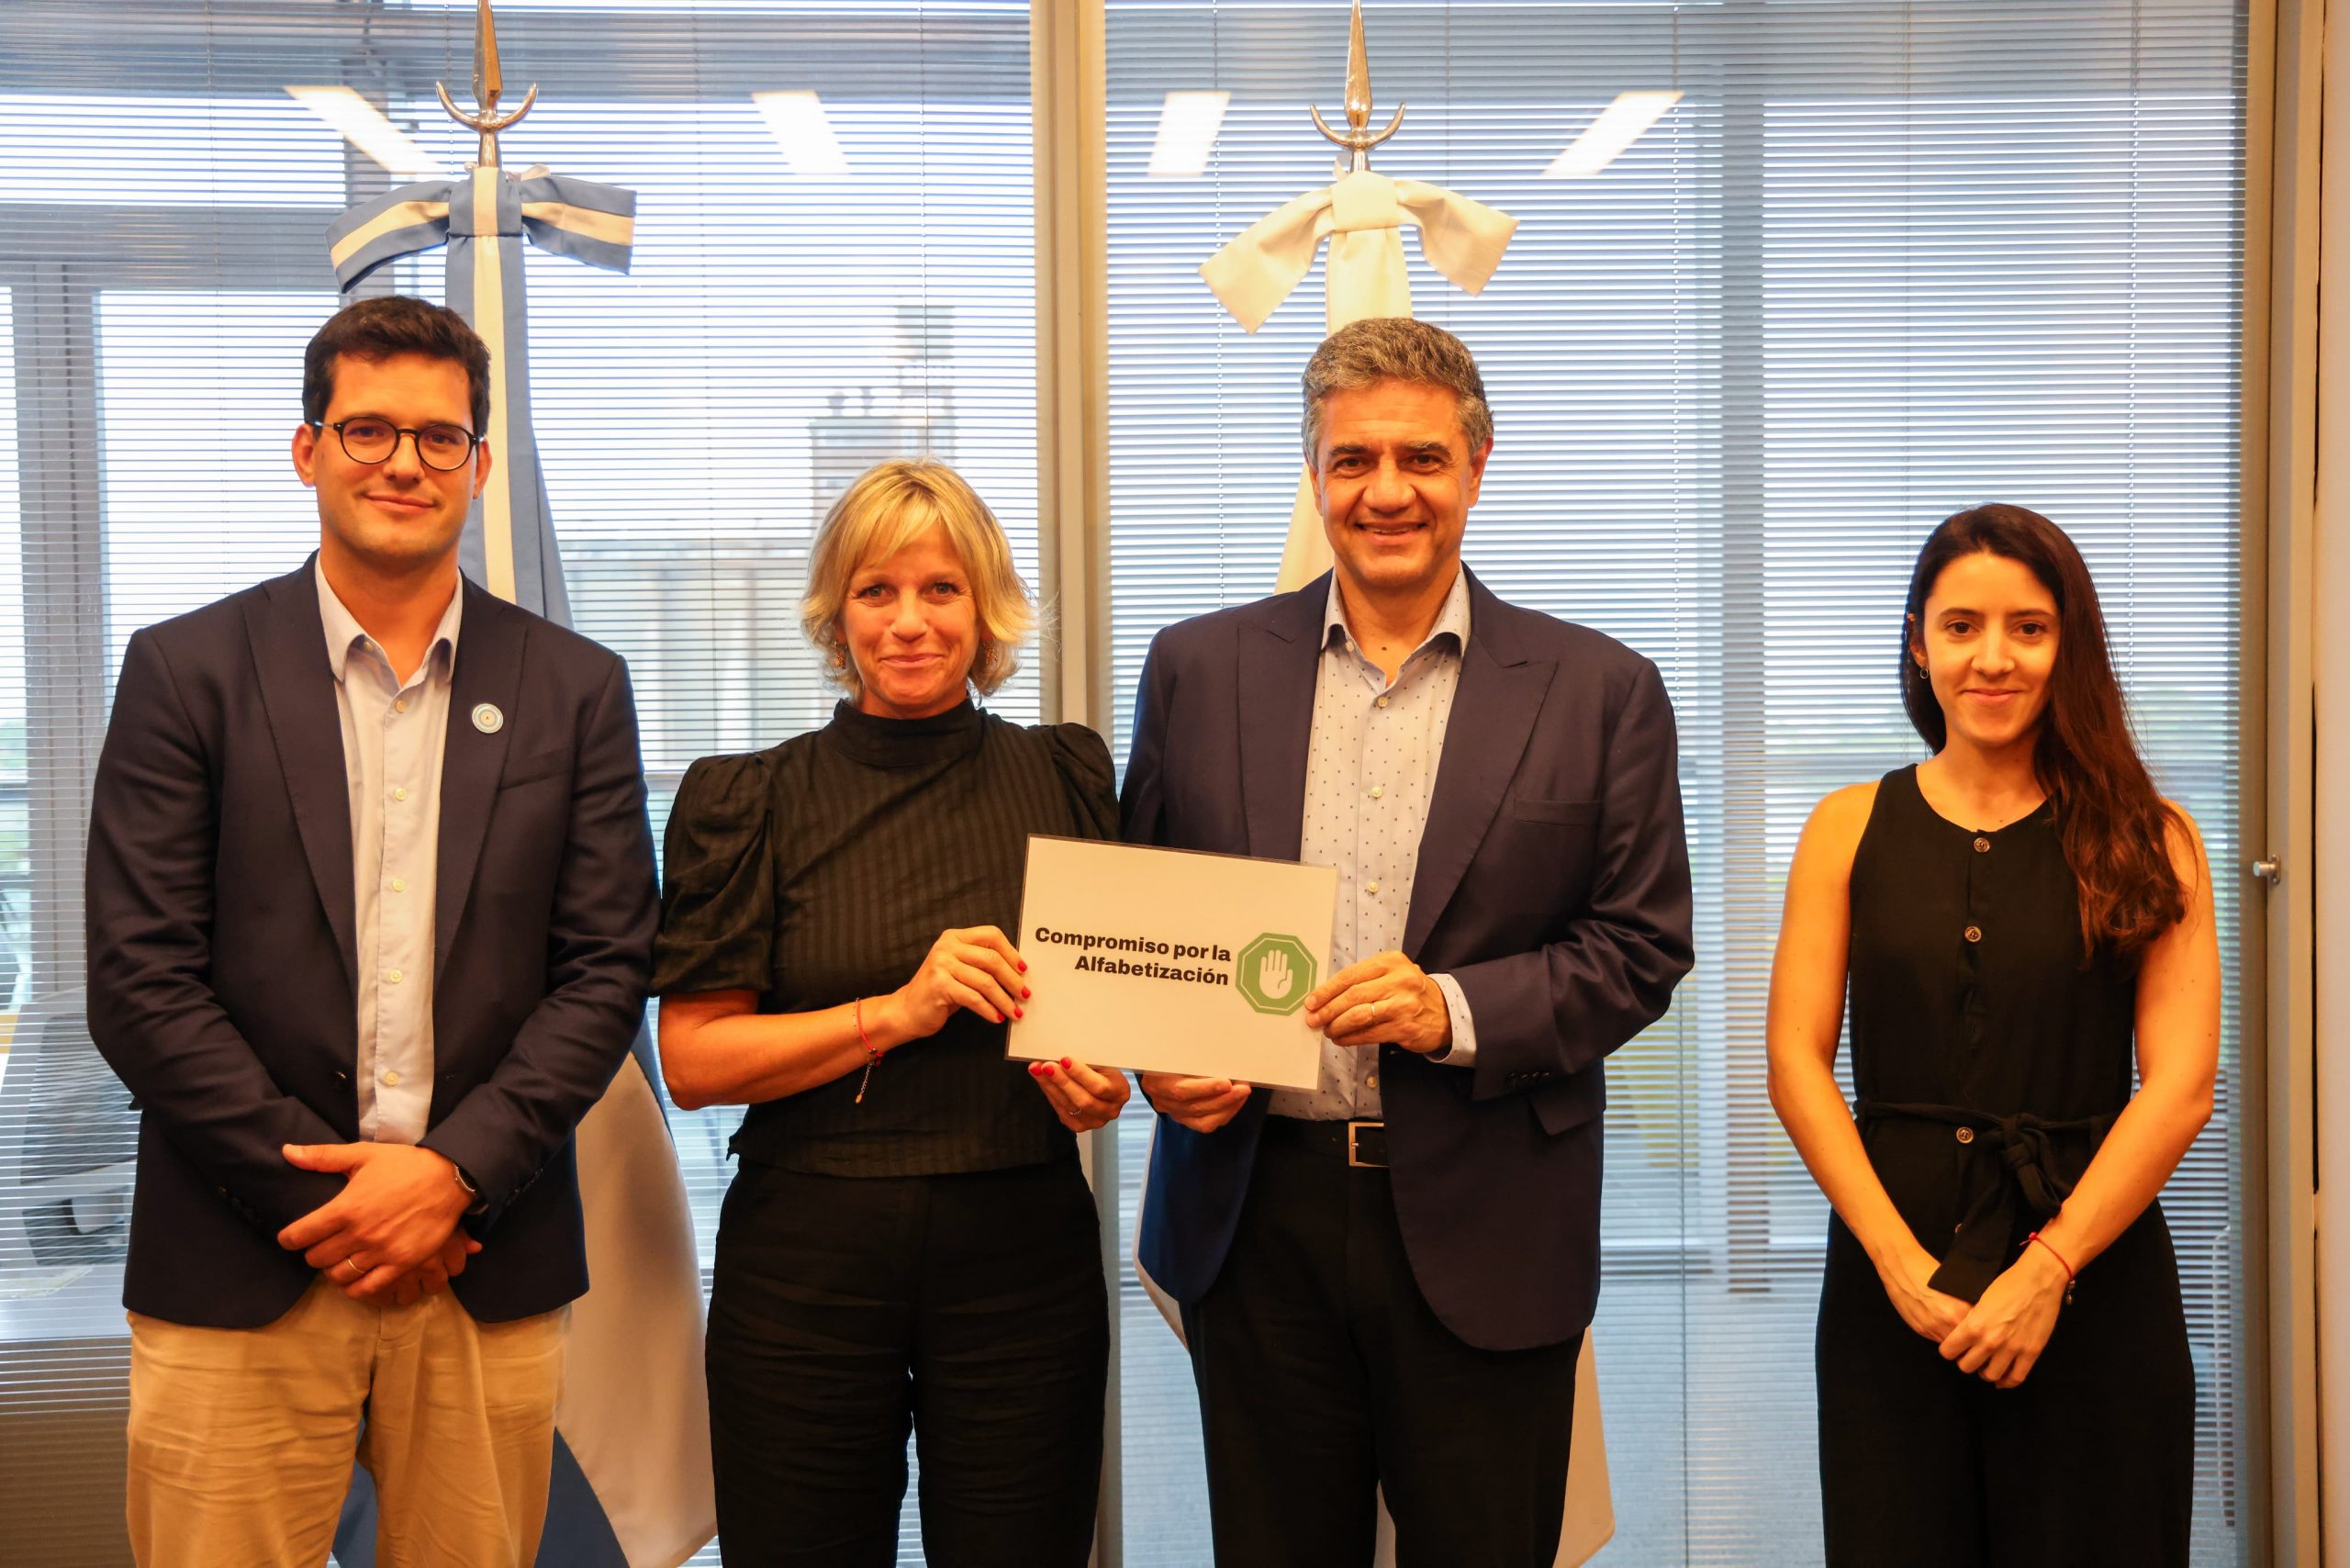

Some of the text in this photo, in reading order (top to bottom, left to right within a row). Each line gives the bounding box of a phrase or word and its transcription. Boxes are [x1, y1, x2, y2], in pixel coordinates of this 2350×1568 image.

[1035, 927, 1231, 962] Compromiso por la
[1074, 956, 1228, 986] Alfabetización
